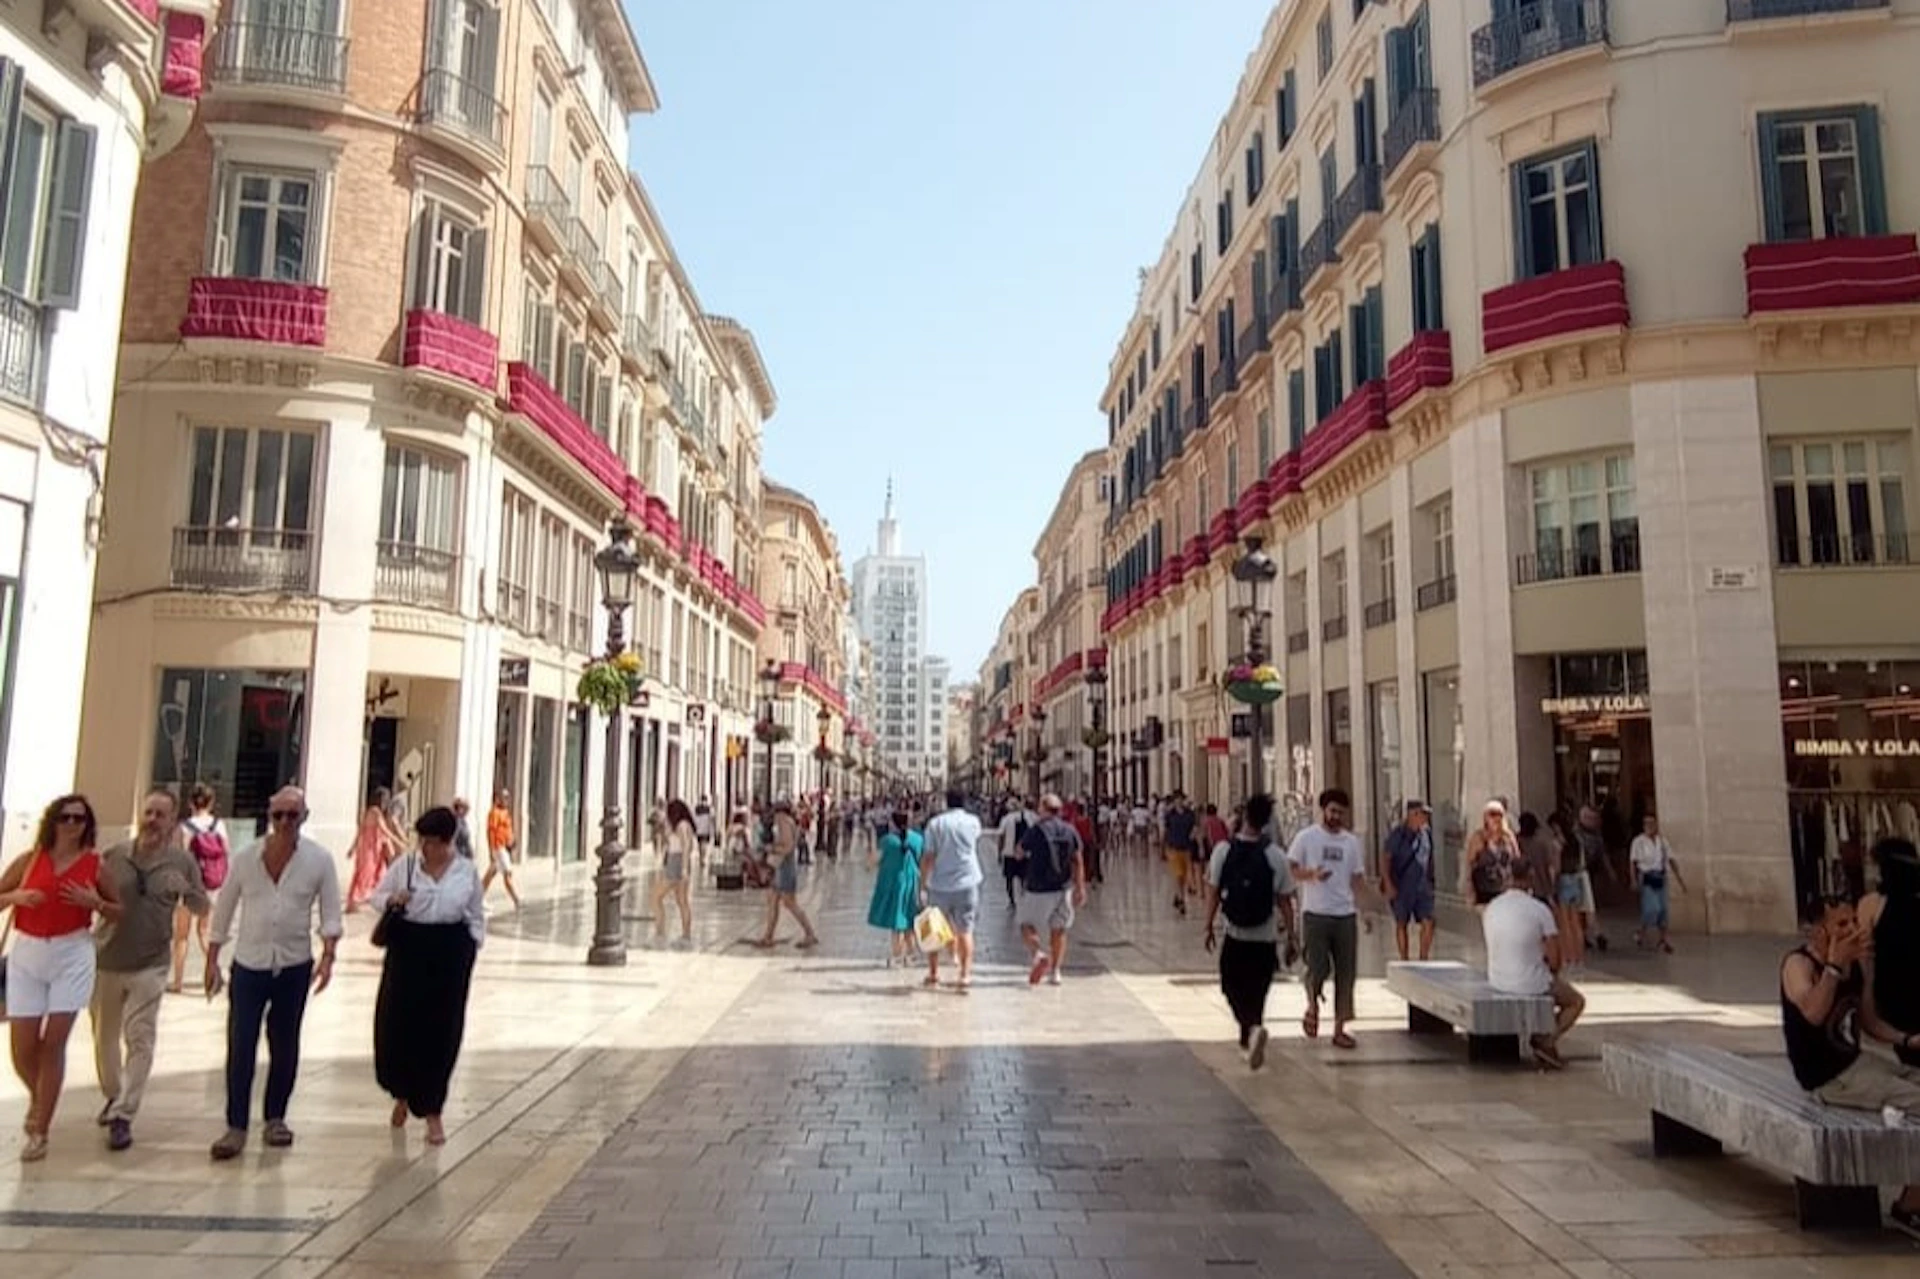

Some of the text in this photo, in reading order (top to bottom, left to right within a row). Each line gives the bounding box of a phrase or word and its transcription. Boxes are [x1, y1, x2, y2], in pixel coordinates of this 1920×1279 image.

[1590, 697, 1601, 712] Y
[1604, 696, 1644, 711] LOLA
[1795, 739, 1920, 756] BIMBA Y LOLA
